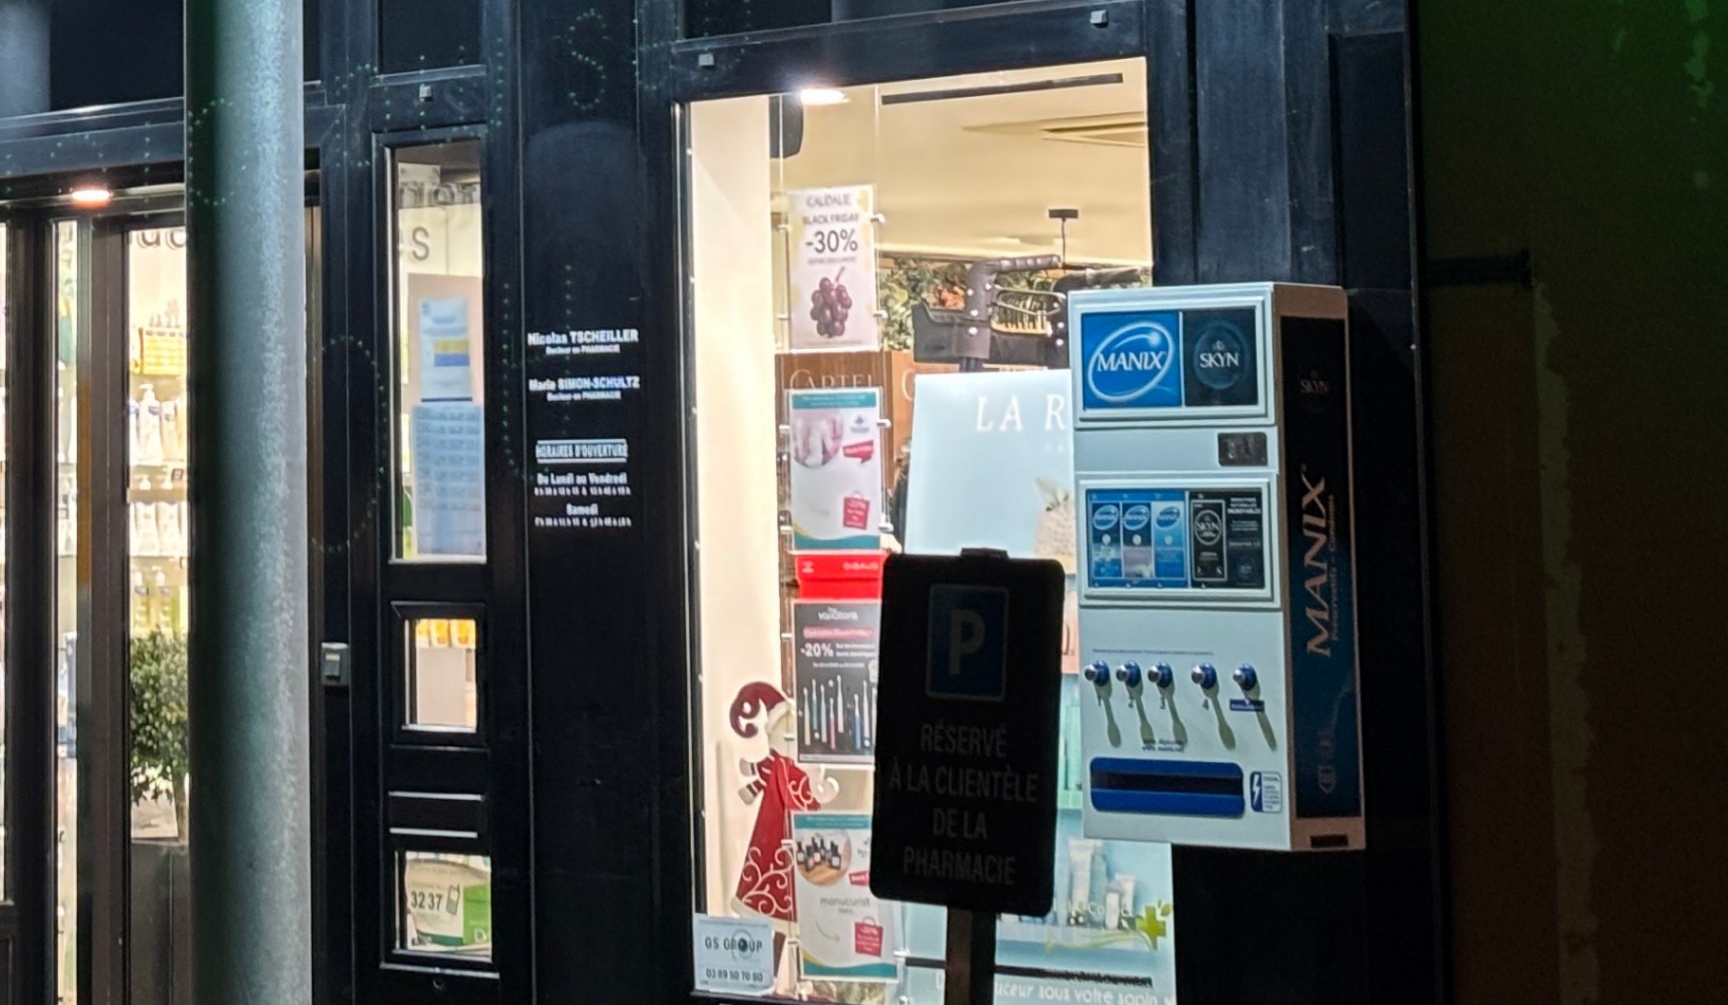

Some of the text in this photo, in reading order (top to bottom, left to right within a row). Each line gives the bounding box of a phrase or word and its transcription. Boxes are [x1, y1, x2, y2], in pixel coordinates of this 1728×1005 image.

[805, 228, 858, 253] -30%
[527, 329, 639, 345] Nicolas TSCHEILLER
[1097, 350, 1164, 372] MANIX
[1199, 353, 1239, 368] SKYN
[557, 375, 640, 391] SIMON-SCHULTZ
[976, 394, 1023, 432] LA
[535, 444, 573, 458] HORAIRES
[1301, 469, 1331, 657] MANIX
[800, 642, 834, 658] -20%
[948, 608, 986, 676] P
[1202, 699, 1209, 711] 4
[920, 718, 1007, 758] RÉSERVÉ
[888, 755, 1039, 803] À LA CLIENTÈLE
[932, 807, 988, 840] DE LA
[903, 845, 1016, 886] PHARMACIE
[410, 890, 443, 912] 32 37
[723, 936, 763, 953] GROUP
[705, 967, 716, 979] 03
[994, 979, 1034, 995] uceur
[1039, 986, 1070, 1001] sous
[1075, 987, 1114, 1003] votre
[1118, 992, 1158, 1005] sapin
